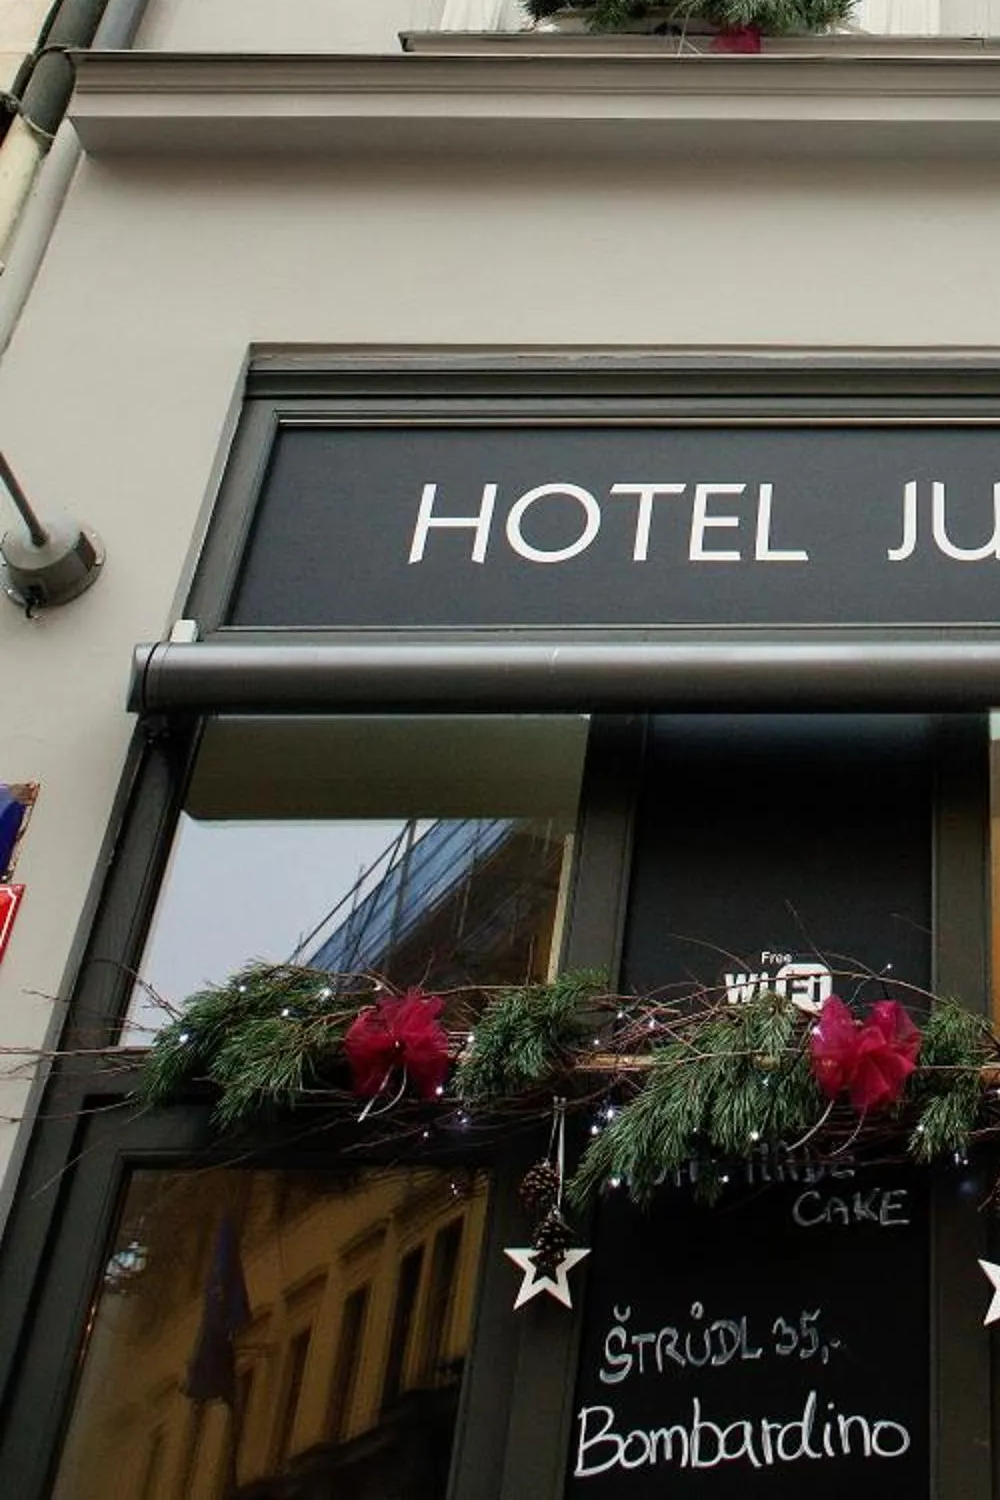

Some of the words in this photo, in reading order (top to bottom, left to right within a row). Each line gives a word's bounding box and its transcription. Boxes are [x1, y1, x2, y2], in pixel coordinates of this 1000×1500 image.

[408, 483, 809, 563] HOTEL
[761, 951, 793, 964] Free
[792, 1188, 911, 1227] CAKE
[574, 1390, 911, 1478] Bombardino
